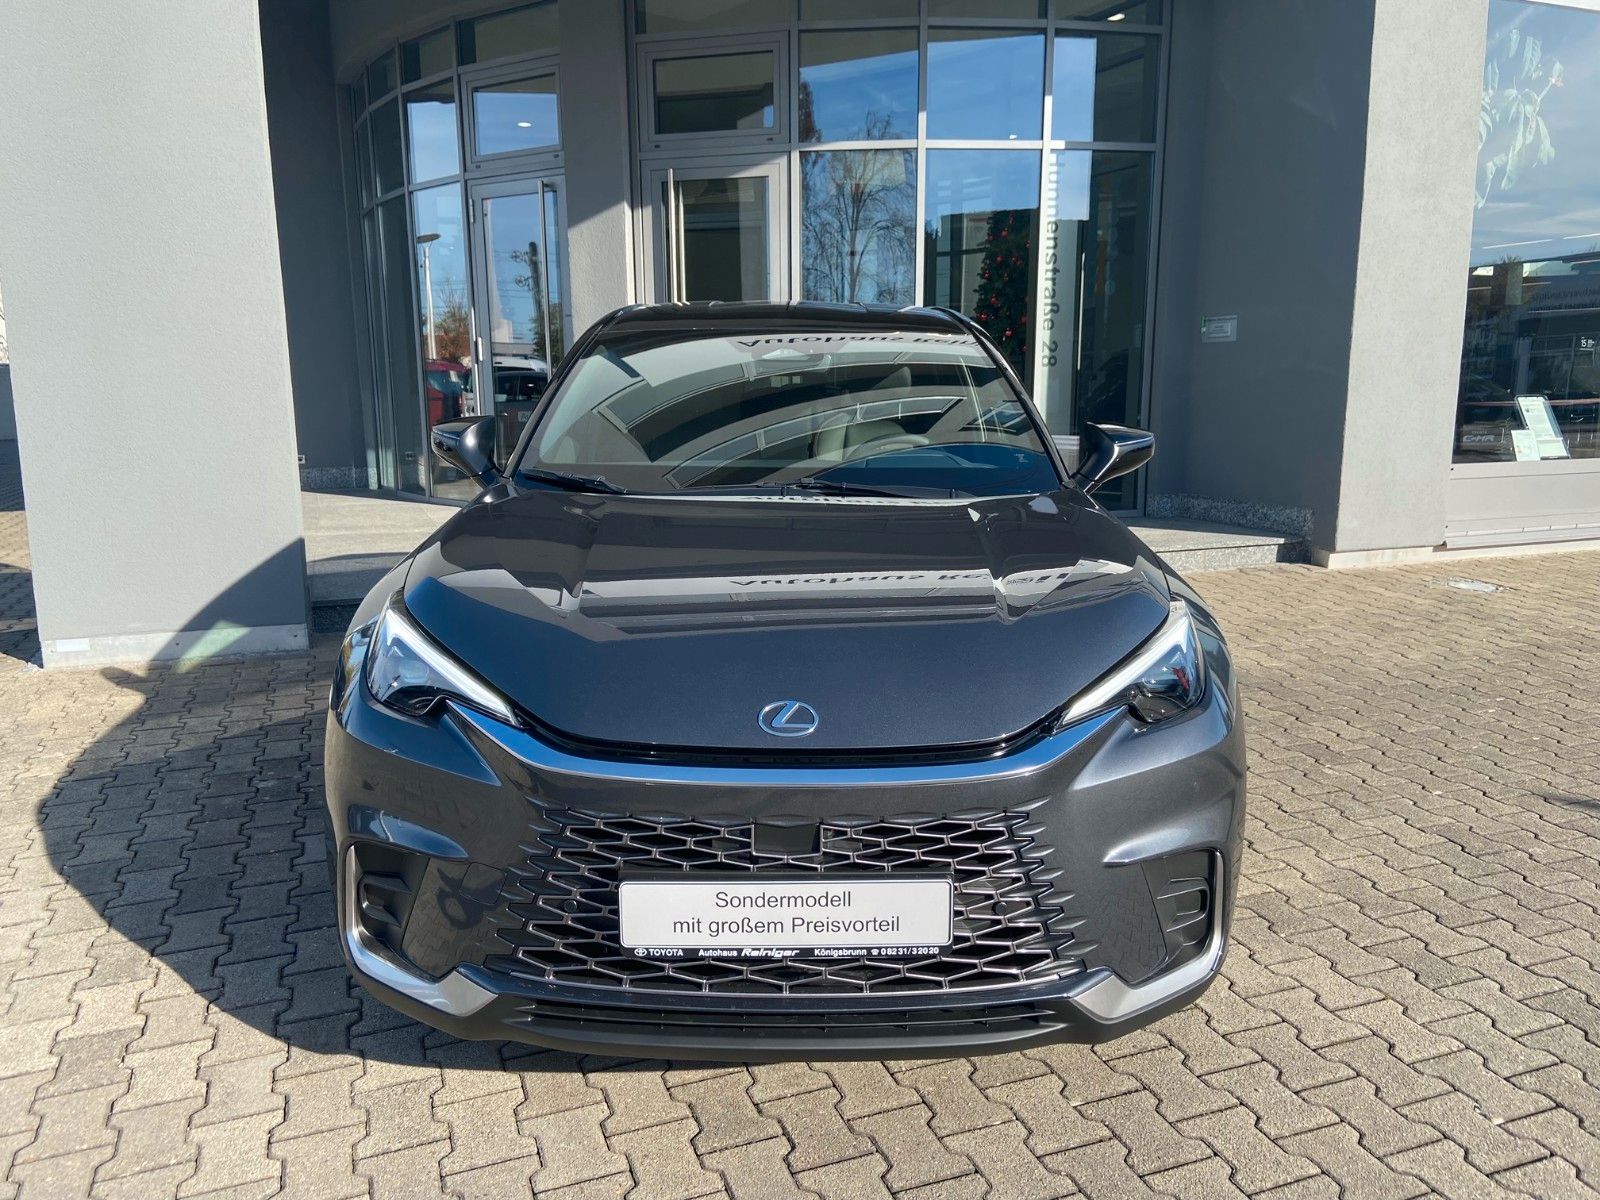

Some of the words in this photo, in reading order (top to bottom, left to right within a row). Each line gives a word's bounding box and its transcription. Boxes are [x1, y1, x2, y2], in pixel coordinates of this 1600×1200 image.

[1041, 341, 1058, 368] 28
[715, 891, 852, 908] Sondermodell
[673, 917, 702, 933] mit
[709, 917, 784, 937] großem
[791, 916, 900, 933] Preisvorteil
[698, 949, 738, 957] Autohaus
[741, 948, 799, 958] Reiniger
[814, 948, 867, 957] Königsbrunn
[880, 947, 939, 956] 08231/32020
